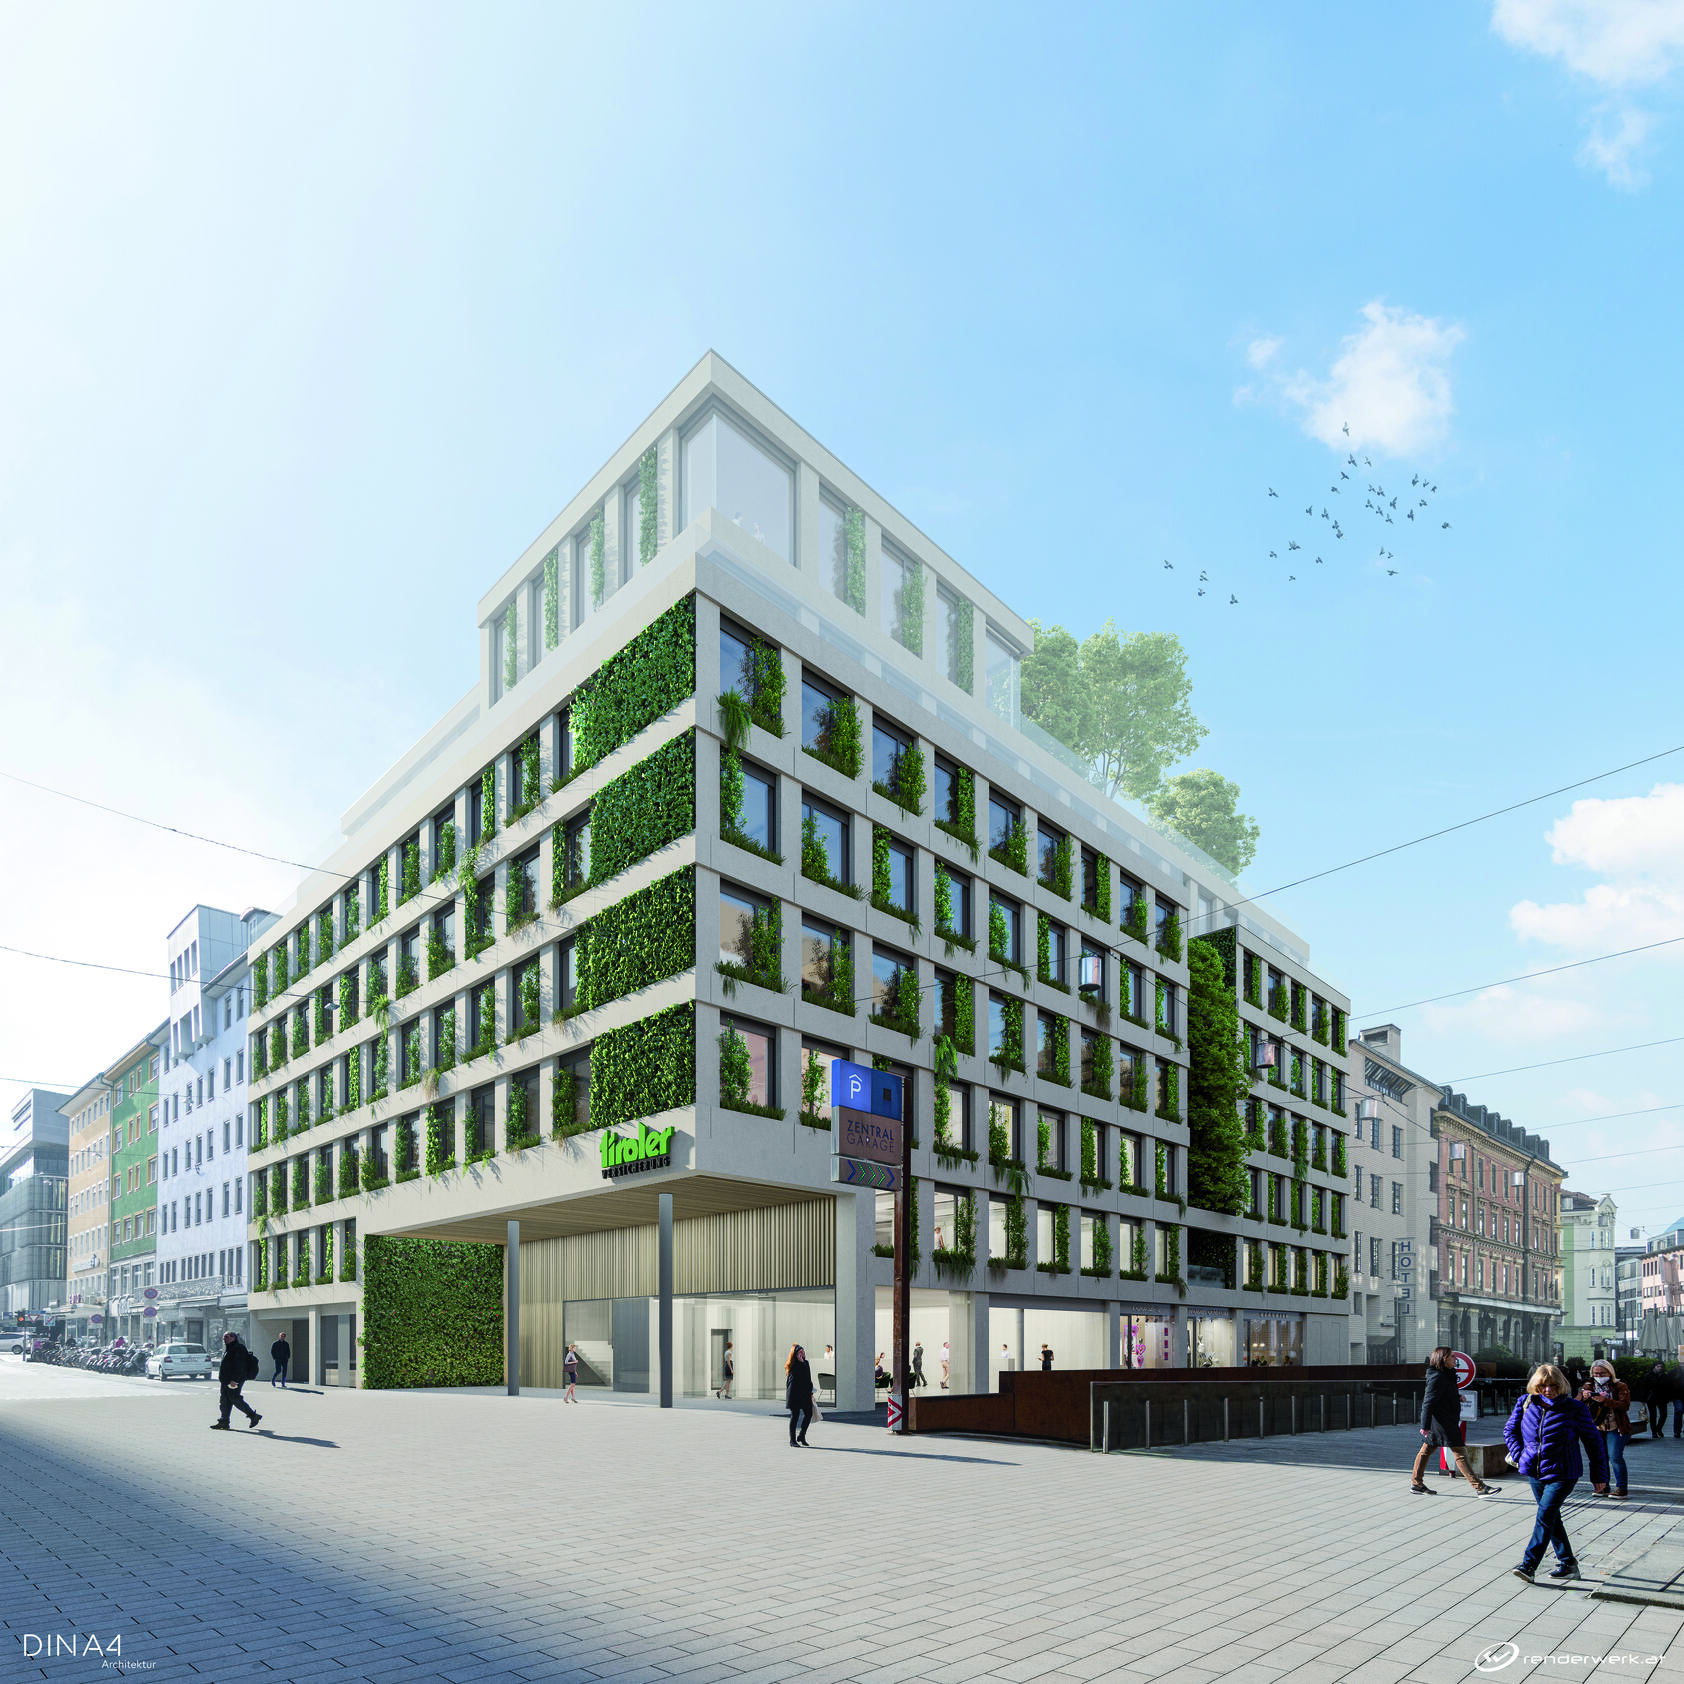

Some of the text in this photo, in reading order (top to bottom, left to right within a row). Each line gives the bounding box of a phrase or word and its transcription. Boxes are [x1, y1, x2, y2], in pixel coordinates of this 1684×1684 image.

[847, 1120, 894, 1141] ZENTRAL
[600, 1121, 675, 1168] tiroler
[846, 1132, 894, 1153] GARAGE
[601, 1155, 671, 1180] VERSICHERUNG
